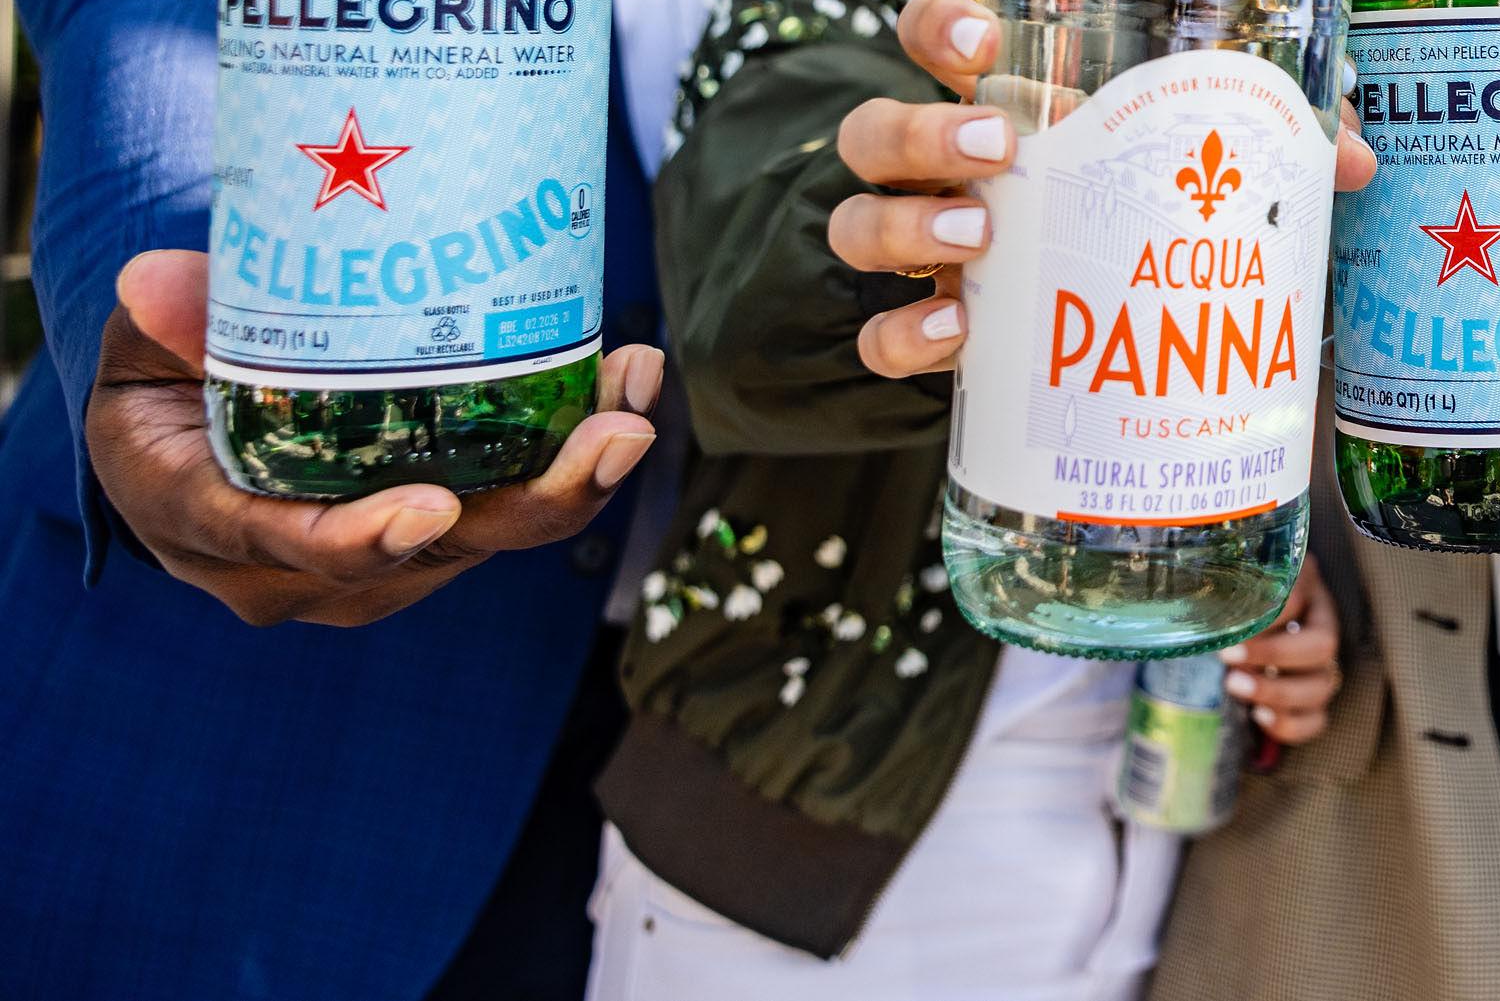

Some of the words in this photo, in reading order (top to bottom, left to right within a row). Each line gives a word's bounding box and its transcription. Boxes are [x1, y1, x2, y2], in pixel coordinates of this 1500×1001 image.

[272, 42, 380, 64] NATURAL
[391, 44, 504, 65] MINERAL
[513, 45, 575, 64] WATER
[1367, 47, 1416, 63] SOURCE,
[1419, 46, 1449, 61] SAN
[337, 66, 381, 79] WATER
[386, 67, 418, 80] WITH
[456, 67, 500, 80] ADDED
[1103, 87, 1157, 134] ELEVATE
[1160, 77, 1200, 98] YOUR
[1207, 76, 1245, 93] TASTE
[1250, 82, 1303, 138] EXPERIENCE
[1395, 133, 1489, 152] NATURAL
[1403, 153, 1448, 166] MINERAL
[1450, 153, 1486, 166] WATER
[1130, 237, 1266, 291] ACQUA
[492, 295, 515, 308] BEST
[531, 289, 552, 303] USED
[261, 327, 287, 350] QT)
[292, 330, 305, 350] (1
[313, 330, 330, 352] L)
[1342, 382, 1352, 398] FL
[1352, 385, 1366, 402] OZ
[1367, 387, 1393, 407] (1.06
[1396, 391, 1420, 413] QT)
[1424, 393, 1436, 413] (1
[1442, 393, 1456, 413] L)
[1118, 412, 1251, 438] TUSCANY
[1054, 453, 1149, 489] NATURAL
[1159, 457, 1233, 489] SPRING
[1239, 446, 1286, 480] WATER
[1079, 490, 1114, 510] 33.8
[1119, 491, 1136, 512] FL
[1142, 491, 1163, 513] OZ
[1169, 490, 1208, 514] (1.06
[1213, 488, 1236, 511] QT)
[1239, 485, 1249, 506] (1
[1255, 481, 1268, 503] L)
